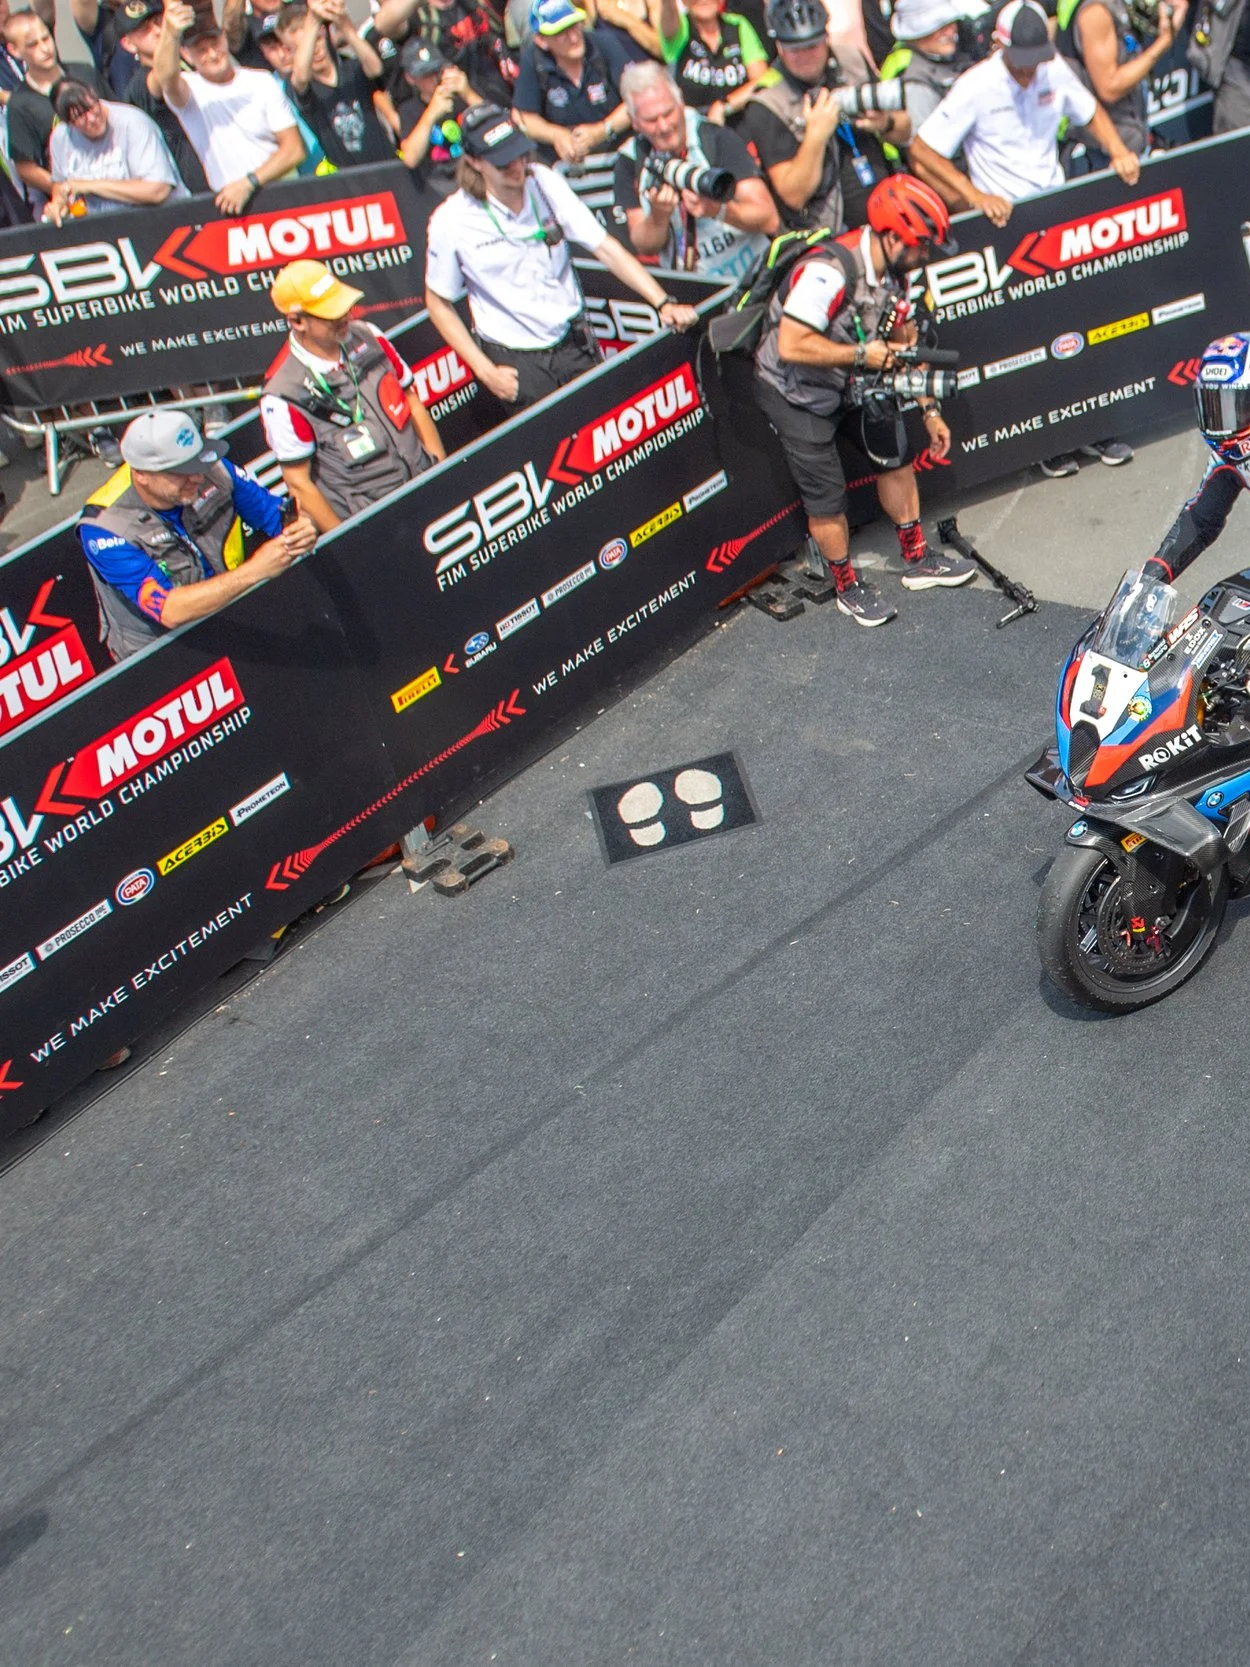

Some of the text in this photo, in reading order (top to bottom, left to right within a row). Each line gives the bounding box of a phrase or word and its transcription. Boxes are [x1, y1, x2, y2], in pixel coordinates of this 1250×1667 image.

[228, 203, 395, 266] MOTUL
[1059, 198, 1180, 262] MOTUL
[32, 289, 157, 328] SUPERBIKE
[158, 272, 241, 306] WORLD
[246, 244, 414, 292] CHIONSHIP
[934, 230, 1190, 325] PERBIKE WORLD CHAMPIONSHIP
[120, 316, 292, 358] WE MAKE EXCITEME
[411, 350, 466, 403] TUL
[430, 382, 479, 422] ONSHIP
[592, 373, 693, 463] MOTUL
[961, 376, 1157, 453] WE MAKE EXCITEMENT
[435, 407, 705, 592] FIM SUPERBIKE WORLD CHAMPIONSHIP
[554, 570, 586, 598] PROSECCO
[507, 603, 537, 627] TISSOT
[532, 570, 698, 696] WE MAKE EXCITEMENT
[0, 641, 84, 719] TUL
[465, 641, 497, 668] SUBARU
[1080, 663, 1111, 720] 1
[96, 671, 235, 787] MOTUL
[1138, 723, 1203, 771] ROKiT
[44, 800, 115, 853] WORLD
[118, 706, 252, 805] CHAMPIONSHIP
[237, 779, 287, 818] PROMETEON
[163, 823, 226, 872] ACERBIS
[123, 876, 147, 896] PATA
[54, 913, 96, 947] PROSECCO
[0, 957, 30, 983] ISSOT
[30, 892, 252, 1063] WE MAKE EXCITEMENT
